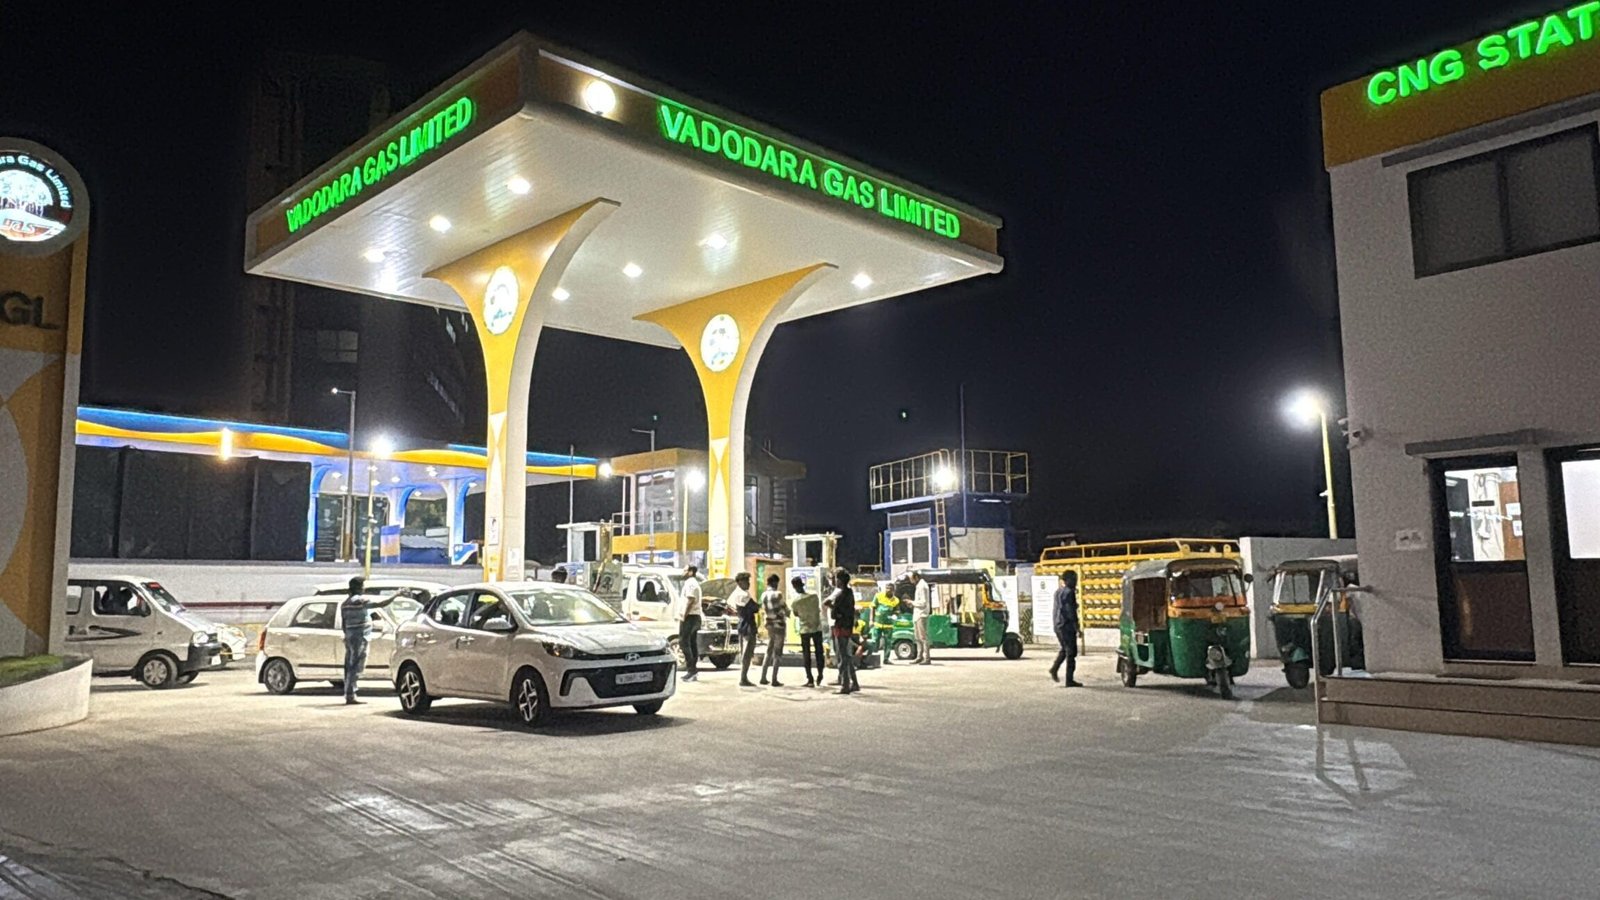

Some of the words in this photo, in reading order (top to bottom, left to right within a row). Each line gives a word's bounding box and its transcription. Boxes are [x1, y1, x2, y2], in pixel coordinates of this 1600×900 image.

[1368, 50, 1464, 105] CNG
[1477, 1, 1600, 70] STAT
[17, 155, 46, 171] Gas
[45, 169, 72, 208] Limited
[286, 167, 363, 232] VADODARA
[363, 142, 399, 185] GAS
[400, 97, 472, 166] LIMITED
[659, 104, 818, 189] VADODARA
[823, 168, 875, 208] GAS
[880, 187, 960, 239] LIMITED
